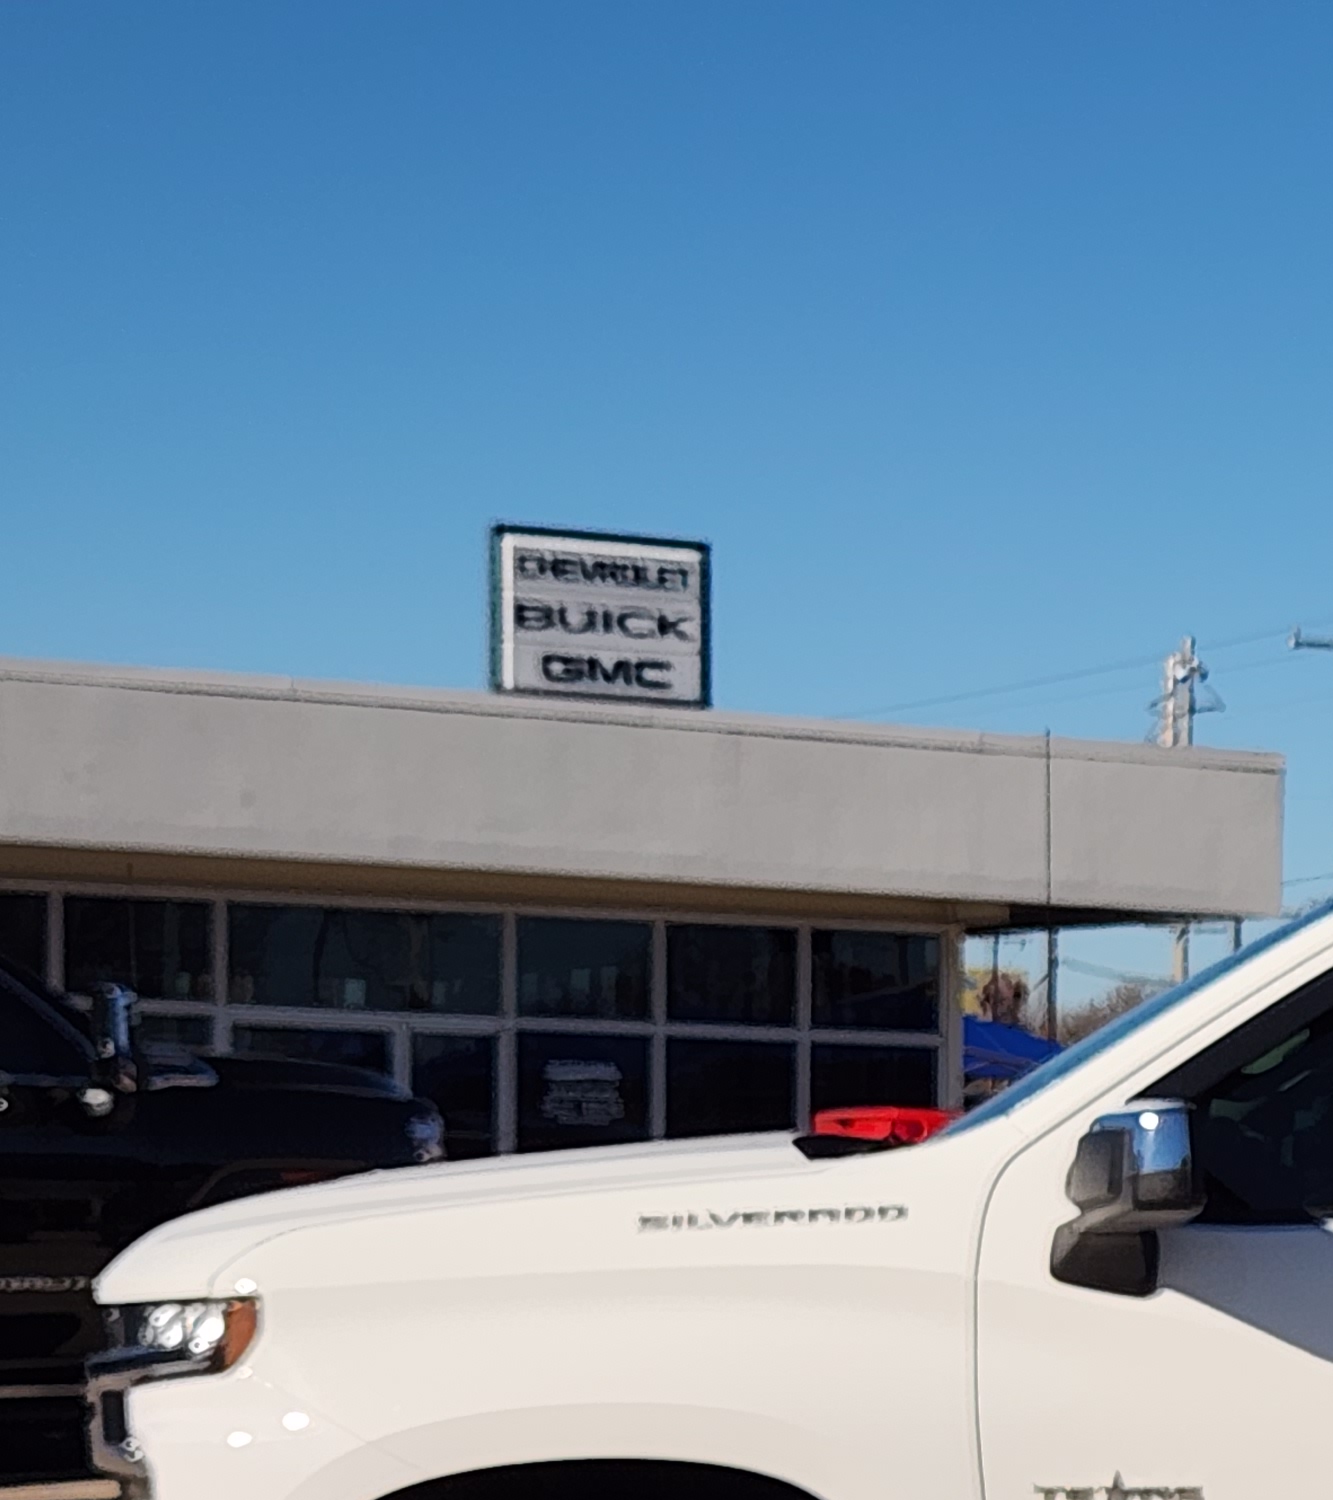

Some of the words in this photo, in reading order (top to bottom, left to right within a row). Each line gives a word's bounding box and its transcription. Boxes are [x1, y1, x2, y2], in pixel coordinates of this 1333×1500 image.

[514, 603, 696, 641] BUICK
[541, 654, 672, 690] GMC
[637, 1204, 909, 1232] SILVERADO
